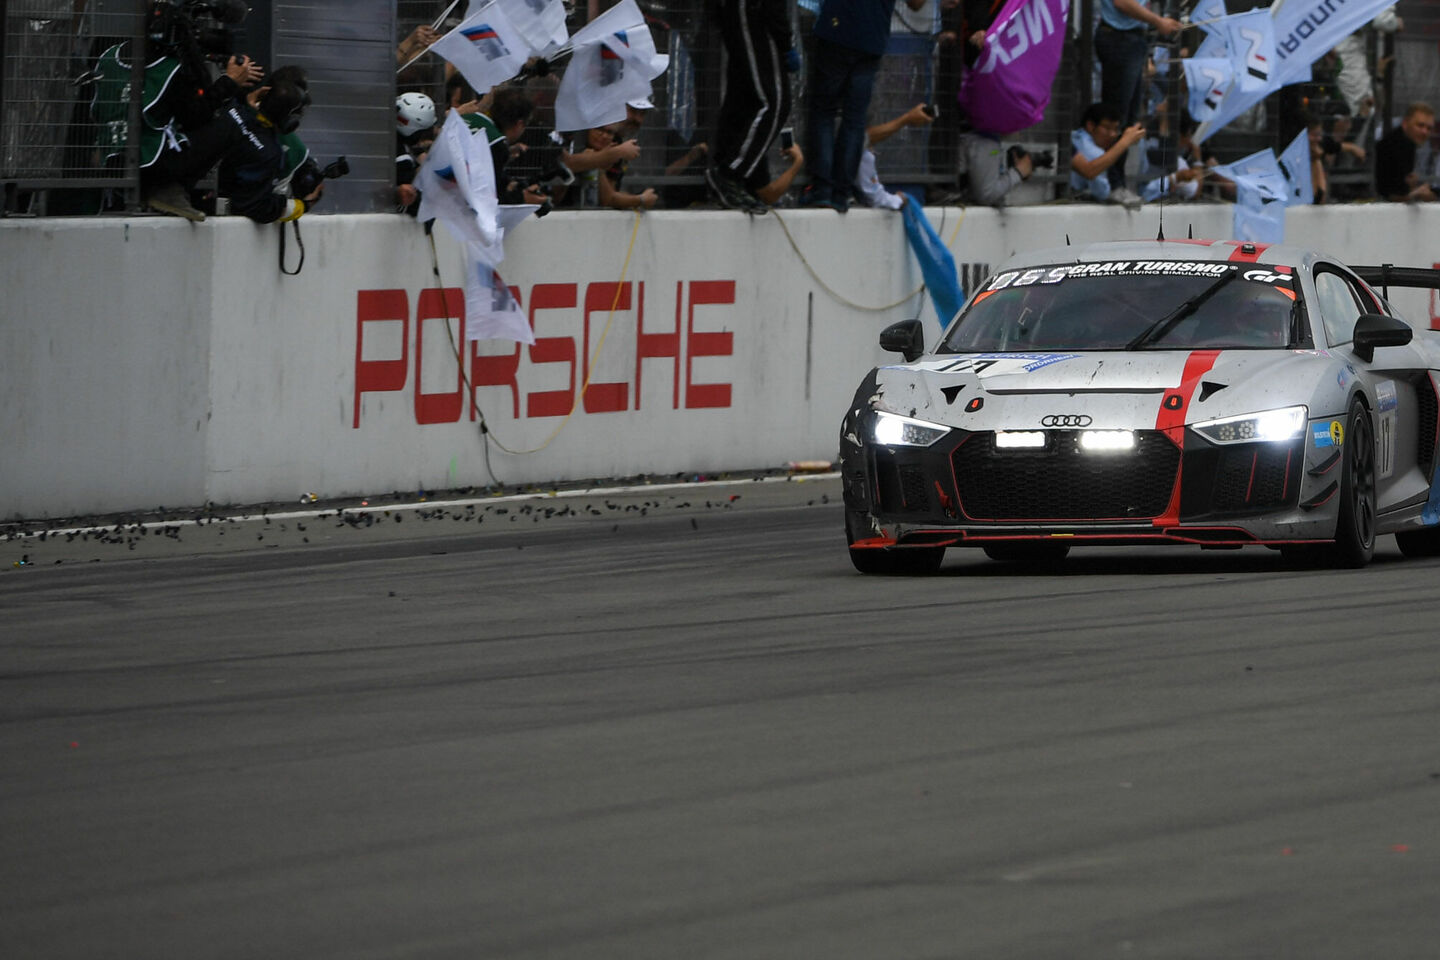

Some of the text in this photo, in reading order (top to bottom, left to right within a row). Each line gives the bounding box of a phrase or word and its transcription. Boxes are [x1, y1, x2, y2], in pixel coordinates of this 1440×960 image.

[1071, 261, 1229, 274] GRAN TURISMO
[353, 279, 736, 430] PORSCHE
